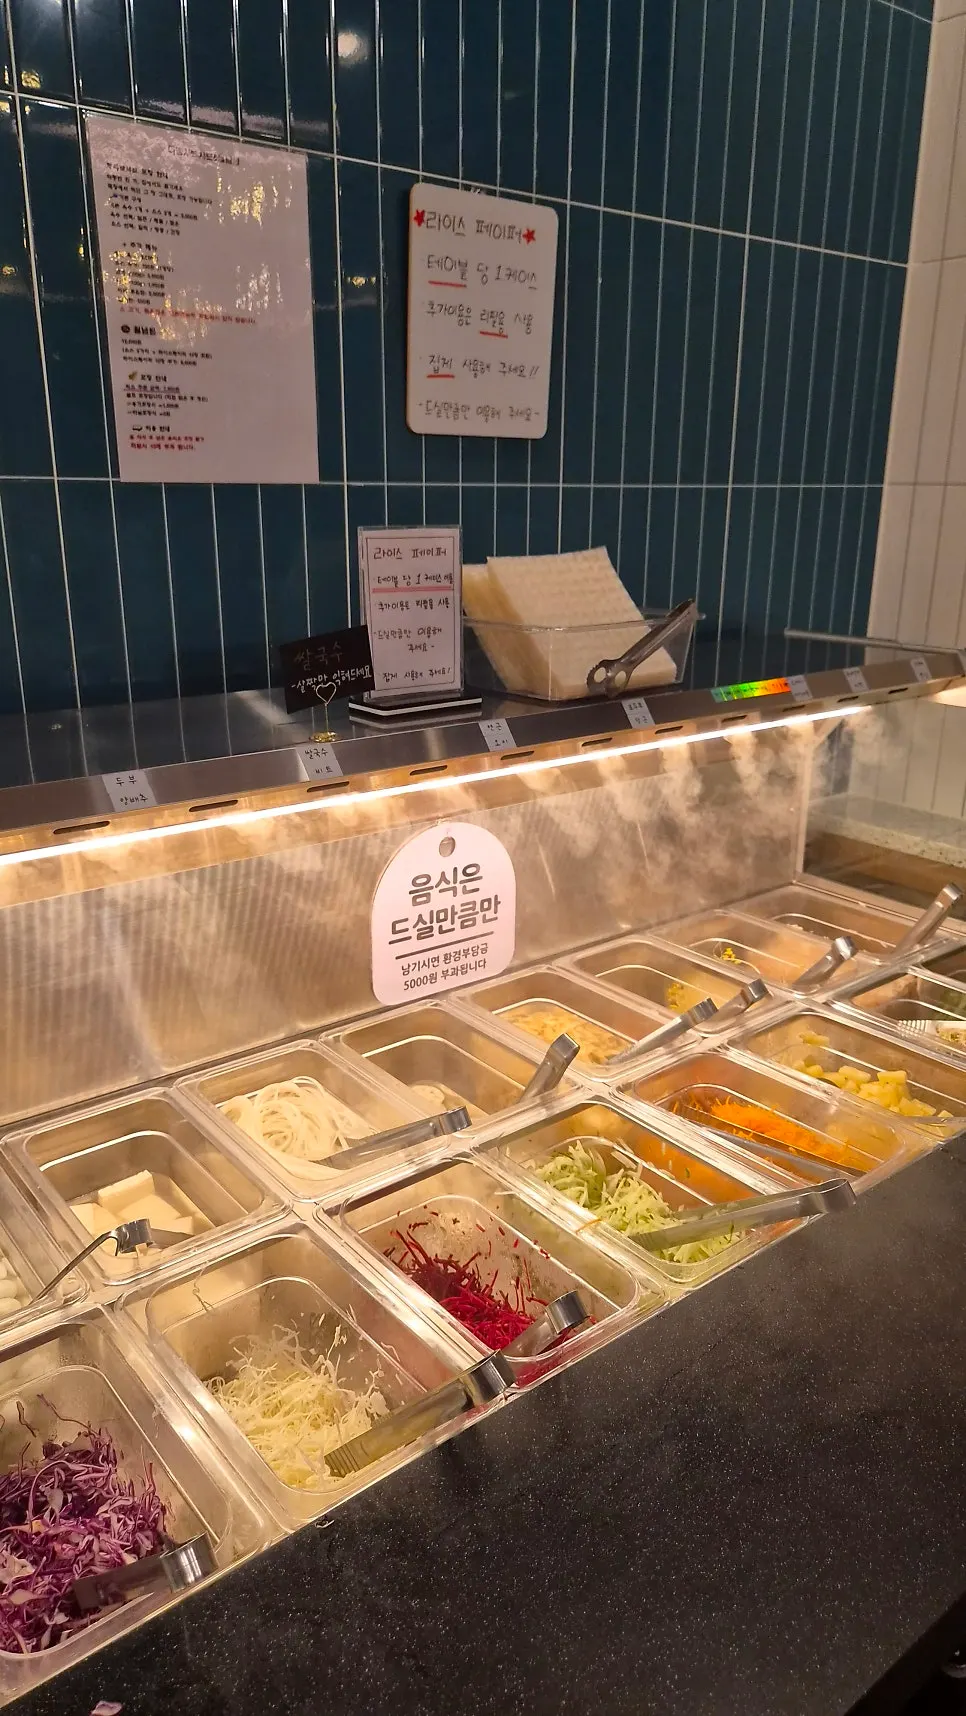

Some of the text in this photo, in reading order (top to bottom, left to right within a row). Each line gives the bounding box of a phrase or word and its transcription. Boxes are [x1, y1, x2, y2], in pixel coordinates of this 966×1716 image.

[426, 211, 521, 243] 라이스 페이퍼
[427, 254, 468, 281] 테이블
[476, 262, 488, 285] 당
[479, 309, 505, 334] 리필용
[513, 311, 534, 335] 사용
[462, 357, 491, 379] 사용해
[476, 404, 501, 423] 이용해
[373, 547, 447, 560] 라이스 페이퍼
[377, 575, 398, 588] 테이블
[403, 574, 411, 586] 당
[438, 596, 450, 609] 사용
[417, 626, 442, 639] 이용해
[294, 640, 344, 671] 쌀국수
[304, 748, 328, 760] 쌀국수
[115, 774, 137, 787] 두부
[315, 765, 333, 774] 비트
[408, 863, 483, 907] 음식은
[388, 894, 501, 945] 드실만큼만
[401, 942, 489, 976] 남기시면 환경부담금
[403, 958, 487, 991] 5000원 부과됩니다
